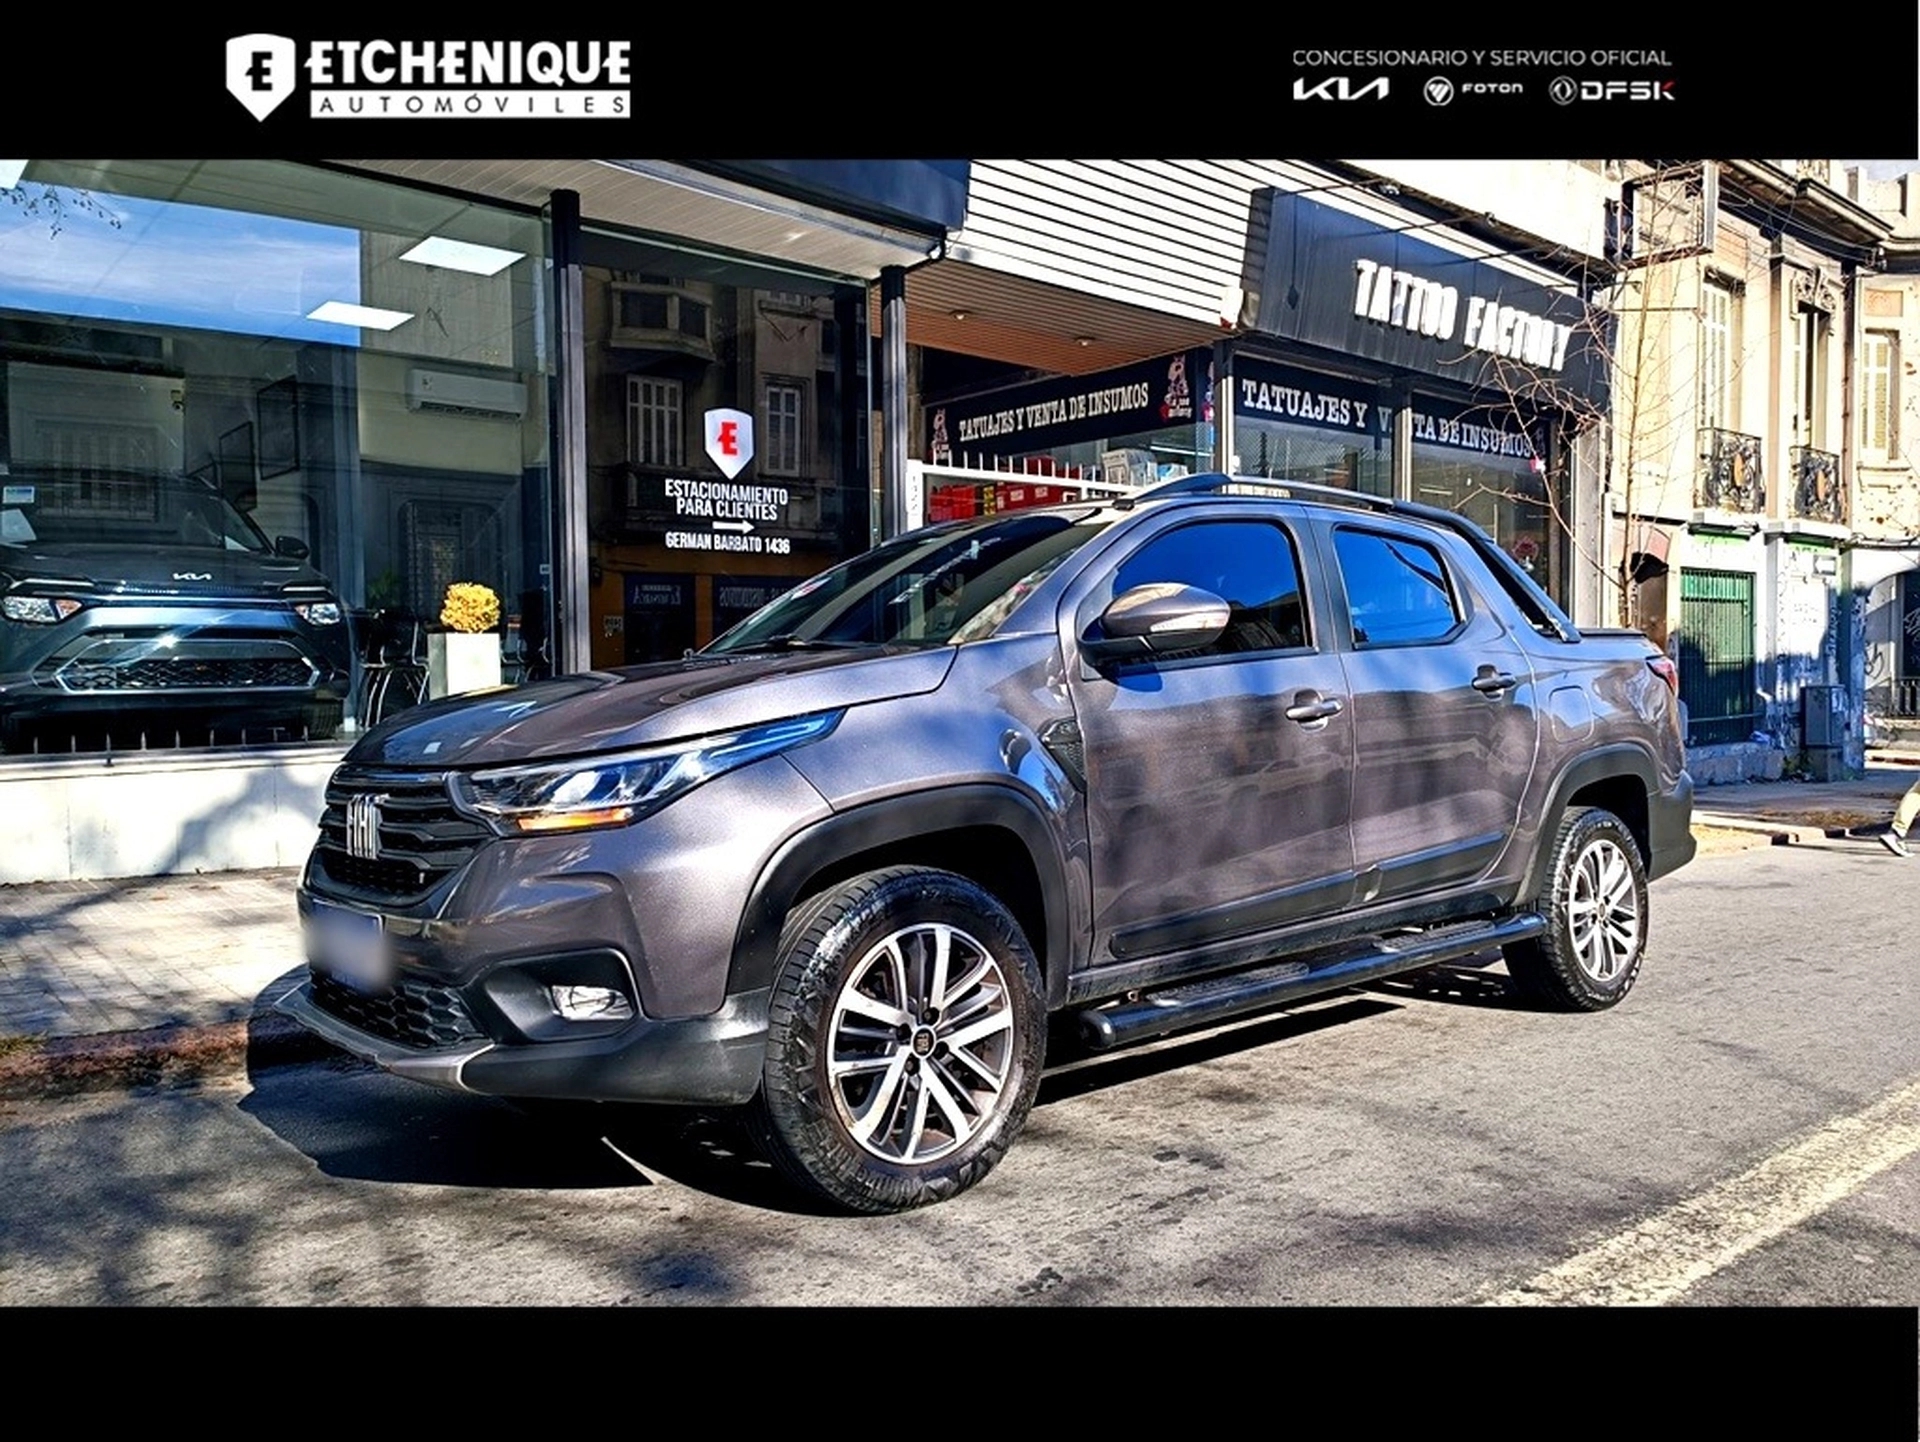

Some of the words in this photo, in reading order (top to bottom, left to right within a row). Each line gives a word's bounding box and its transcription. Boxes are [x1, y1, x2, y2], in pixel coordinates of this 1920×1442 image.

[1354, 258, 1458, 341] TATTOO
[1463, 295, 1573, 372] FACTORY
[959, 410, 1015, 442] TATUAJES
[1015, 407, 1025, 430] Y
[1026, 399, 1067, 429] VENTA
[1068, 395, 1086, 420] DE
[1087, 382, 1149, 416] INSUMOS
[1242, 378, 1351, 426] TATUAJES
[1353, 400, 1368, 429] Y
[1377, 406, 1437, 441] VTA
[1438, 417, 1460, 443] DE
[1461, 422, 1533, 458] INSUMOS
[665, 478, 788, 505] ESTACIONAMIENTO
[676, 497, 714, 517] PARA
[716, 500, 778, 521] CLIENTES
[665, 531, 712, 549] GERMAN
[714, 534, 762, 552] BARBATO
[764, 537, 791, 554] 1436
